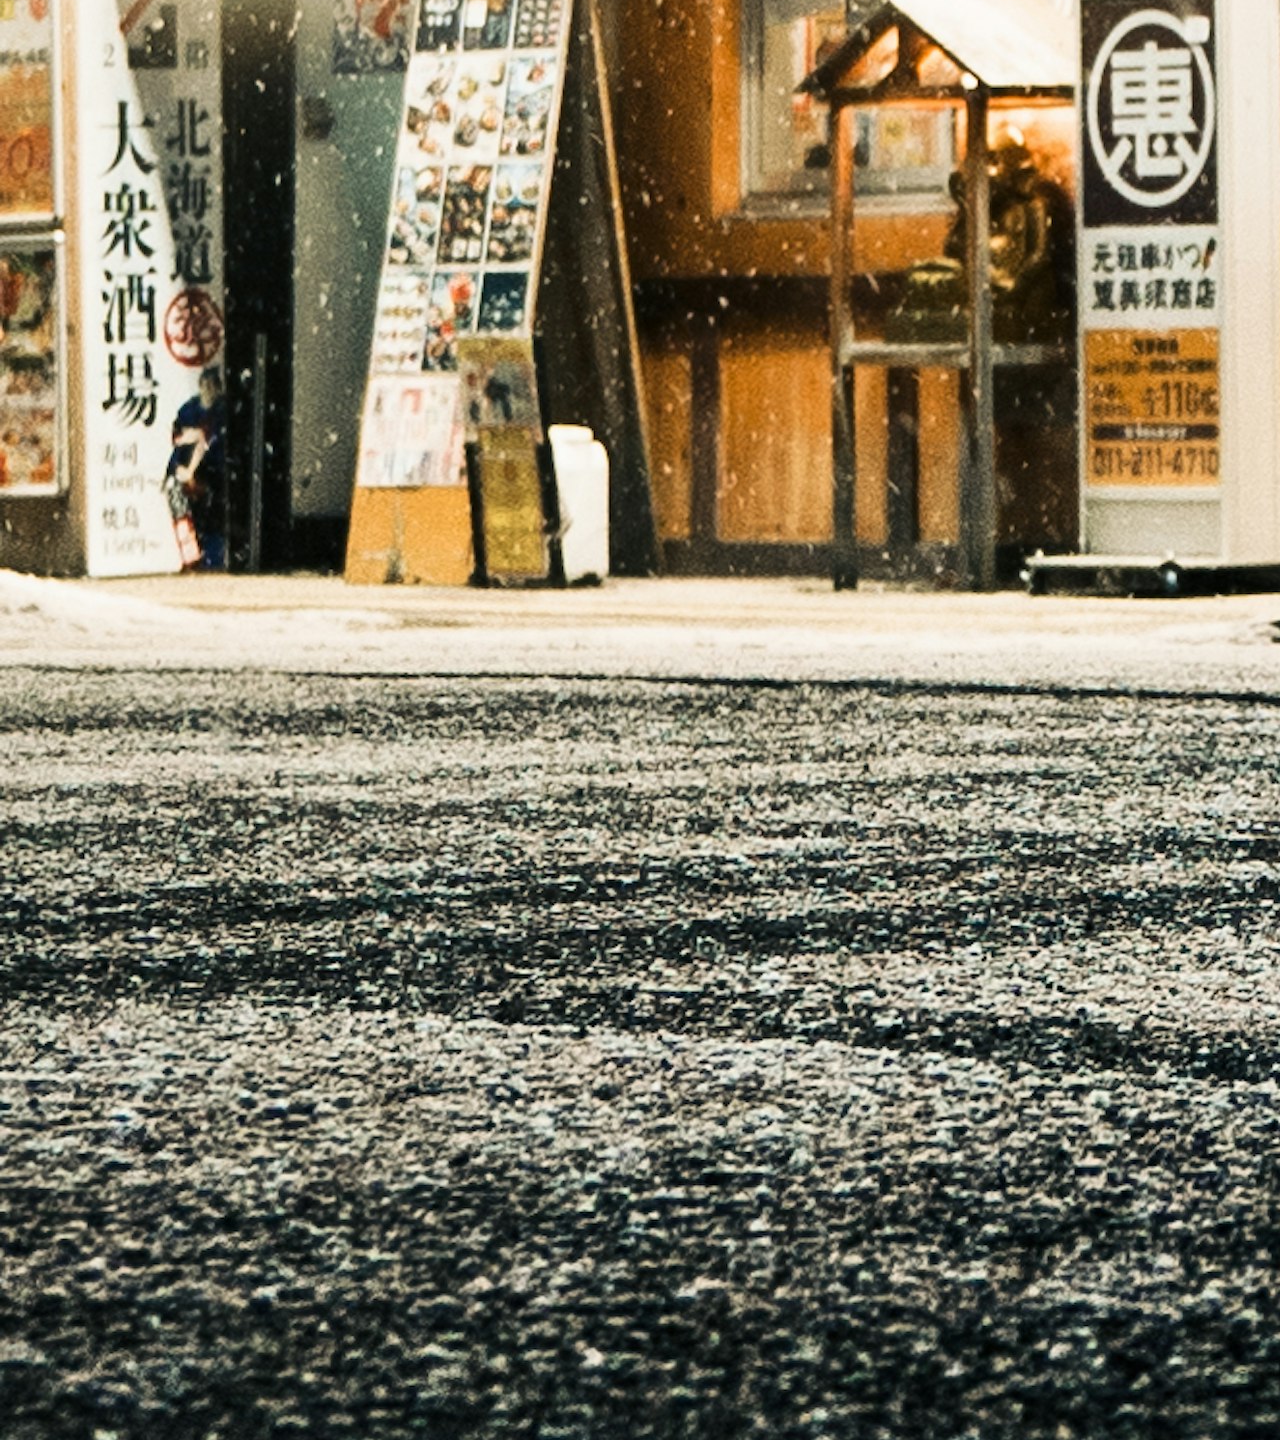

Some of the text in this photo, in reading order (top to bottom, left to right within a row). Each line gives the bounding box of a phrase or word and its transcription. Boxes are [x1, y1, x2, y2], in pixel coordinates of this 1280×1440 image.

[100, 99, 160, 430] 大衆酒場
[165, 97, 213, 286] 北海道
